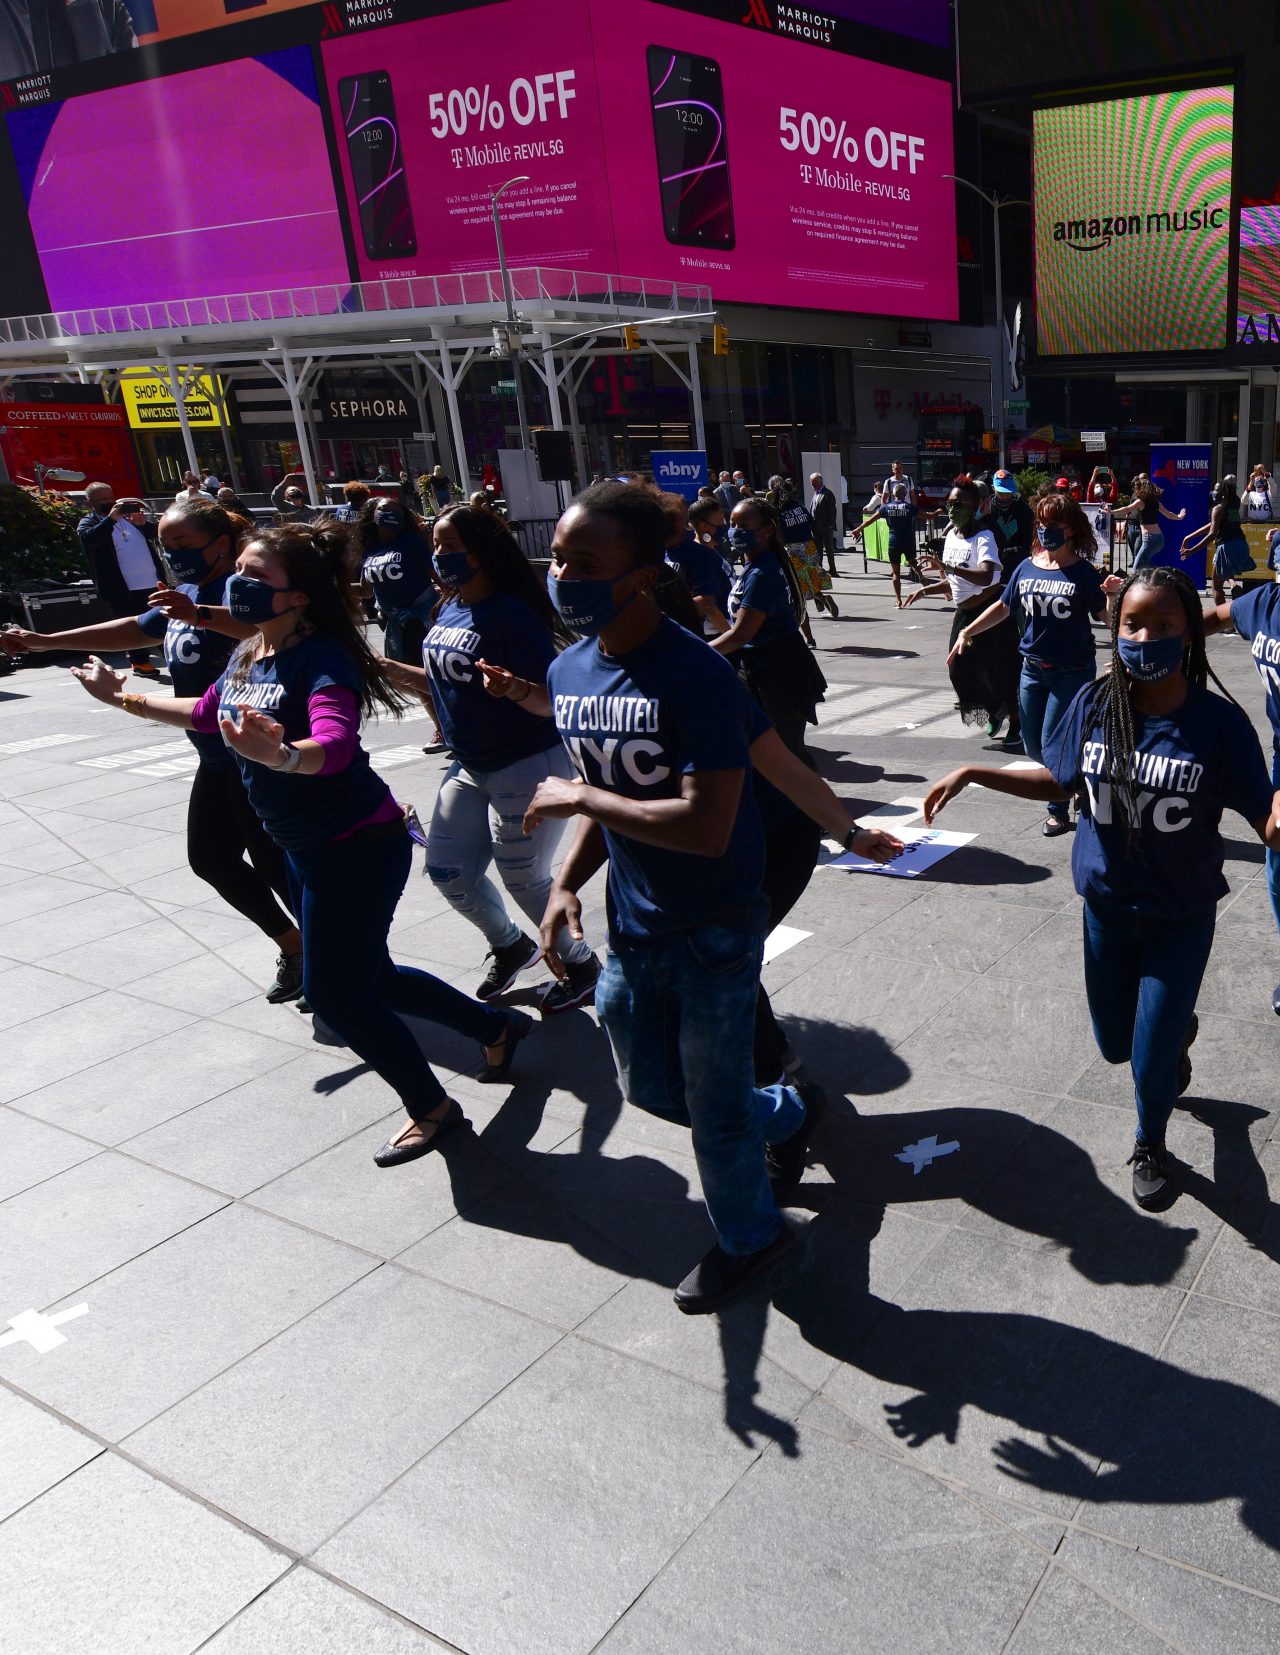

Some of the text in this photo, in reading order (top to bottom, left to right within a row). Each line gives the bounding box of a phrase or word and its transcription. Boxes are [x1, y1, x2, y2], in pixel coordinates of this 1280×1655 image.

[348, 8, 393, 27] MARQUIS
[777, 4, 837, 30] MARRIOTT
[778, 20, 831, 43] MARQUIS
[16, 75, 51, 91] MARRIOTT
[19, 89, 51, 103] MARQUIS
[428, 69, 576, 139] 50% OFF
[675, 109, 704, 126] 12:00
[362, 128, 383, 143] 12:00
[779, 106, 925, 174] 50% OFF
[465, 142, 512, 168] Mobile
[514, 141, 549, 160] REVVL
[549, 139, 564, 156] 5G
[815, 167, 862, 194] Mobile
[865, 180, 897, 199] REVVL
[897, 186, 911, 201] 5G
[791, 217, 813, 226] wireless
[1053, 202, 1223, 242] amazon music
[134, 384, 158, 399] SHOP
[8, 410, 122, 422] COFFEED SWEET CHURROS
[139, 405, 210, 419] INVICTASTOES.COM
[330, 399, 408, 418] SEPHORA
[659, 460, 701, 480] abny
[1176, 459, 1209, 470] NEW YORK
[1249, 503, 1270, 512] NYC
[364, 563, 404, 584] NYC
[1033, 579, 1077, 597] COUNTED
[1021, 594, 1072, 619] NYC
[554, 694, 660, 734] GET COUNTED
[560, 736, 671, 787] NYC
[1084, 775, 1193, 833] NYC
